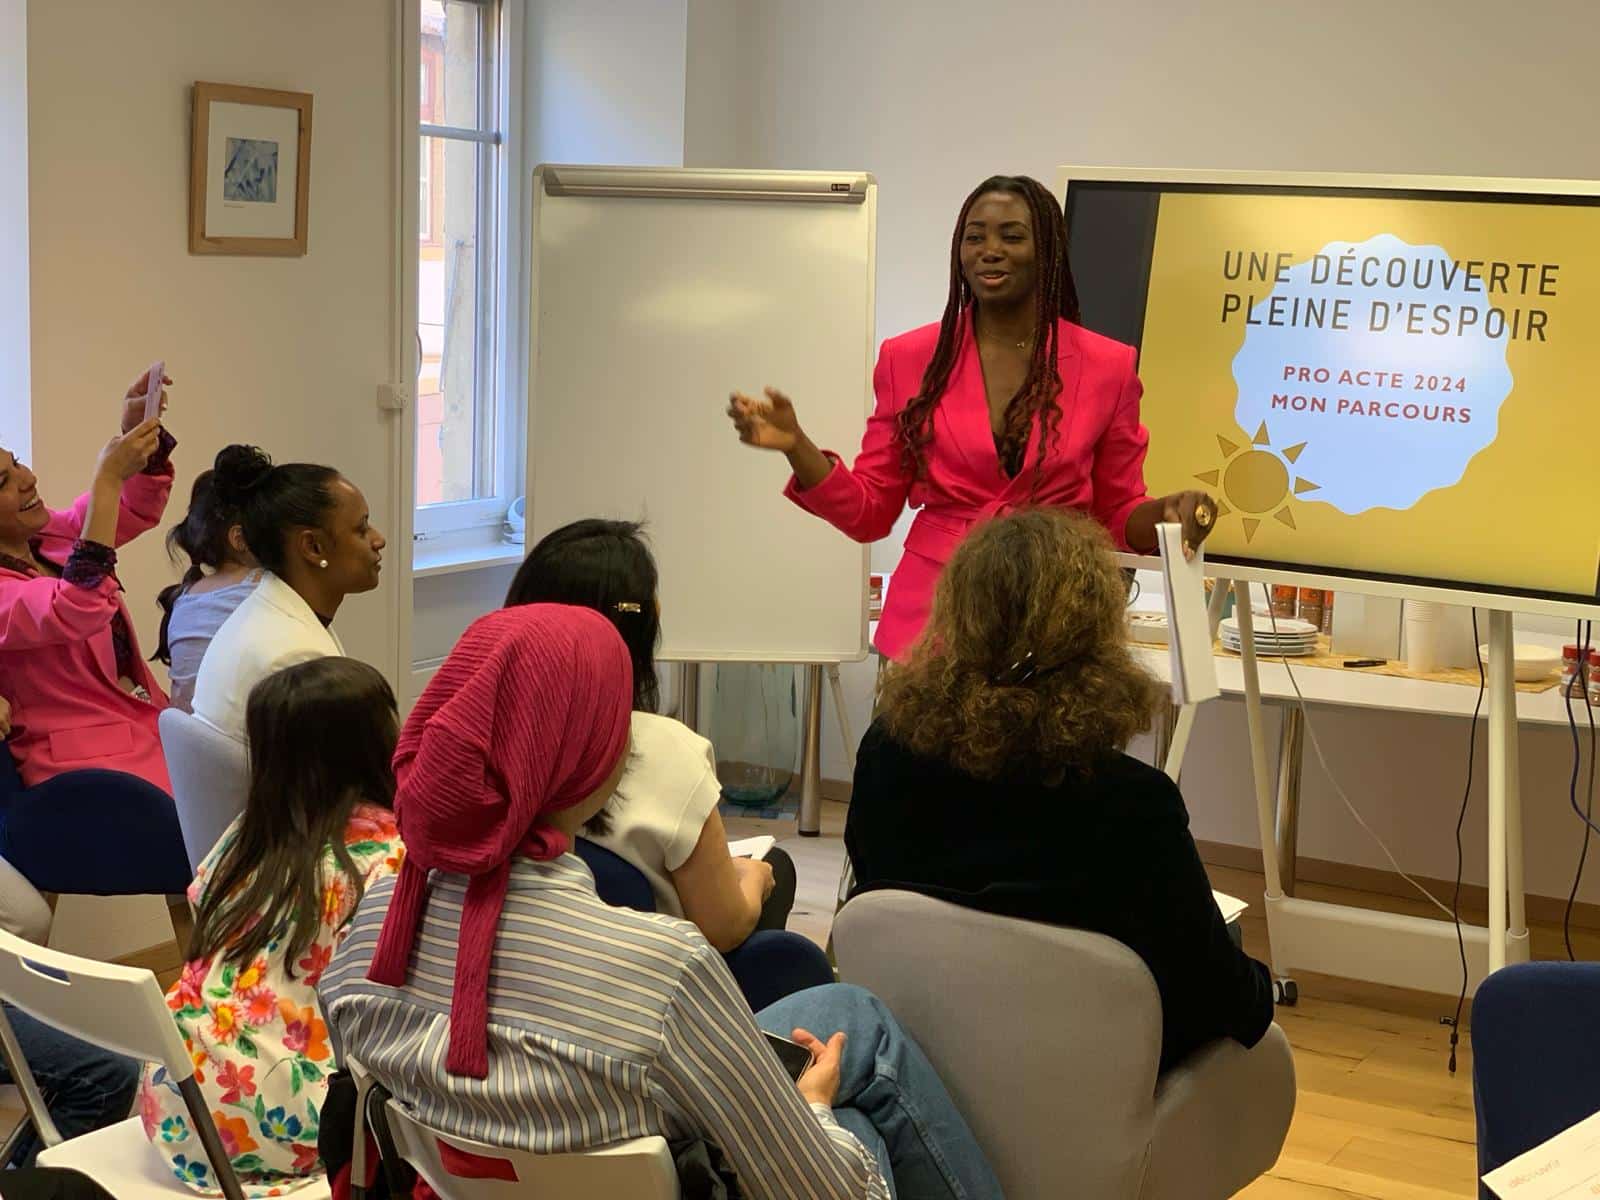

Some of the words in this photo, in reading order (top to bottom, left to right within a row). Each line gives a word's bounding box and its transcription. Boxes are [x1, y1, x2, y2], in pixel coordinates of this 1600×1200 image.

[1223, 251, 1293, 282] UNE
[1310, 248, 1560, 296] DÉCOUVERTE
[1221, 294, 1351, 330] PLEINE
[1369, 302, 1549, 341] D'ESPOIR
[1283, 366, 1330, 384] PRO
[1338, 370, 1404, 389] ACTE
[1414, 375, 1467, 393] 2024
[1271, 394, 1327, 413] MON
[1337, 399, 1472, 424] PARCOURS
